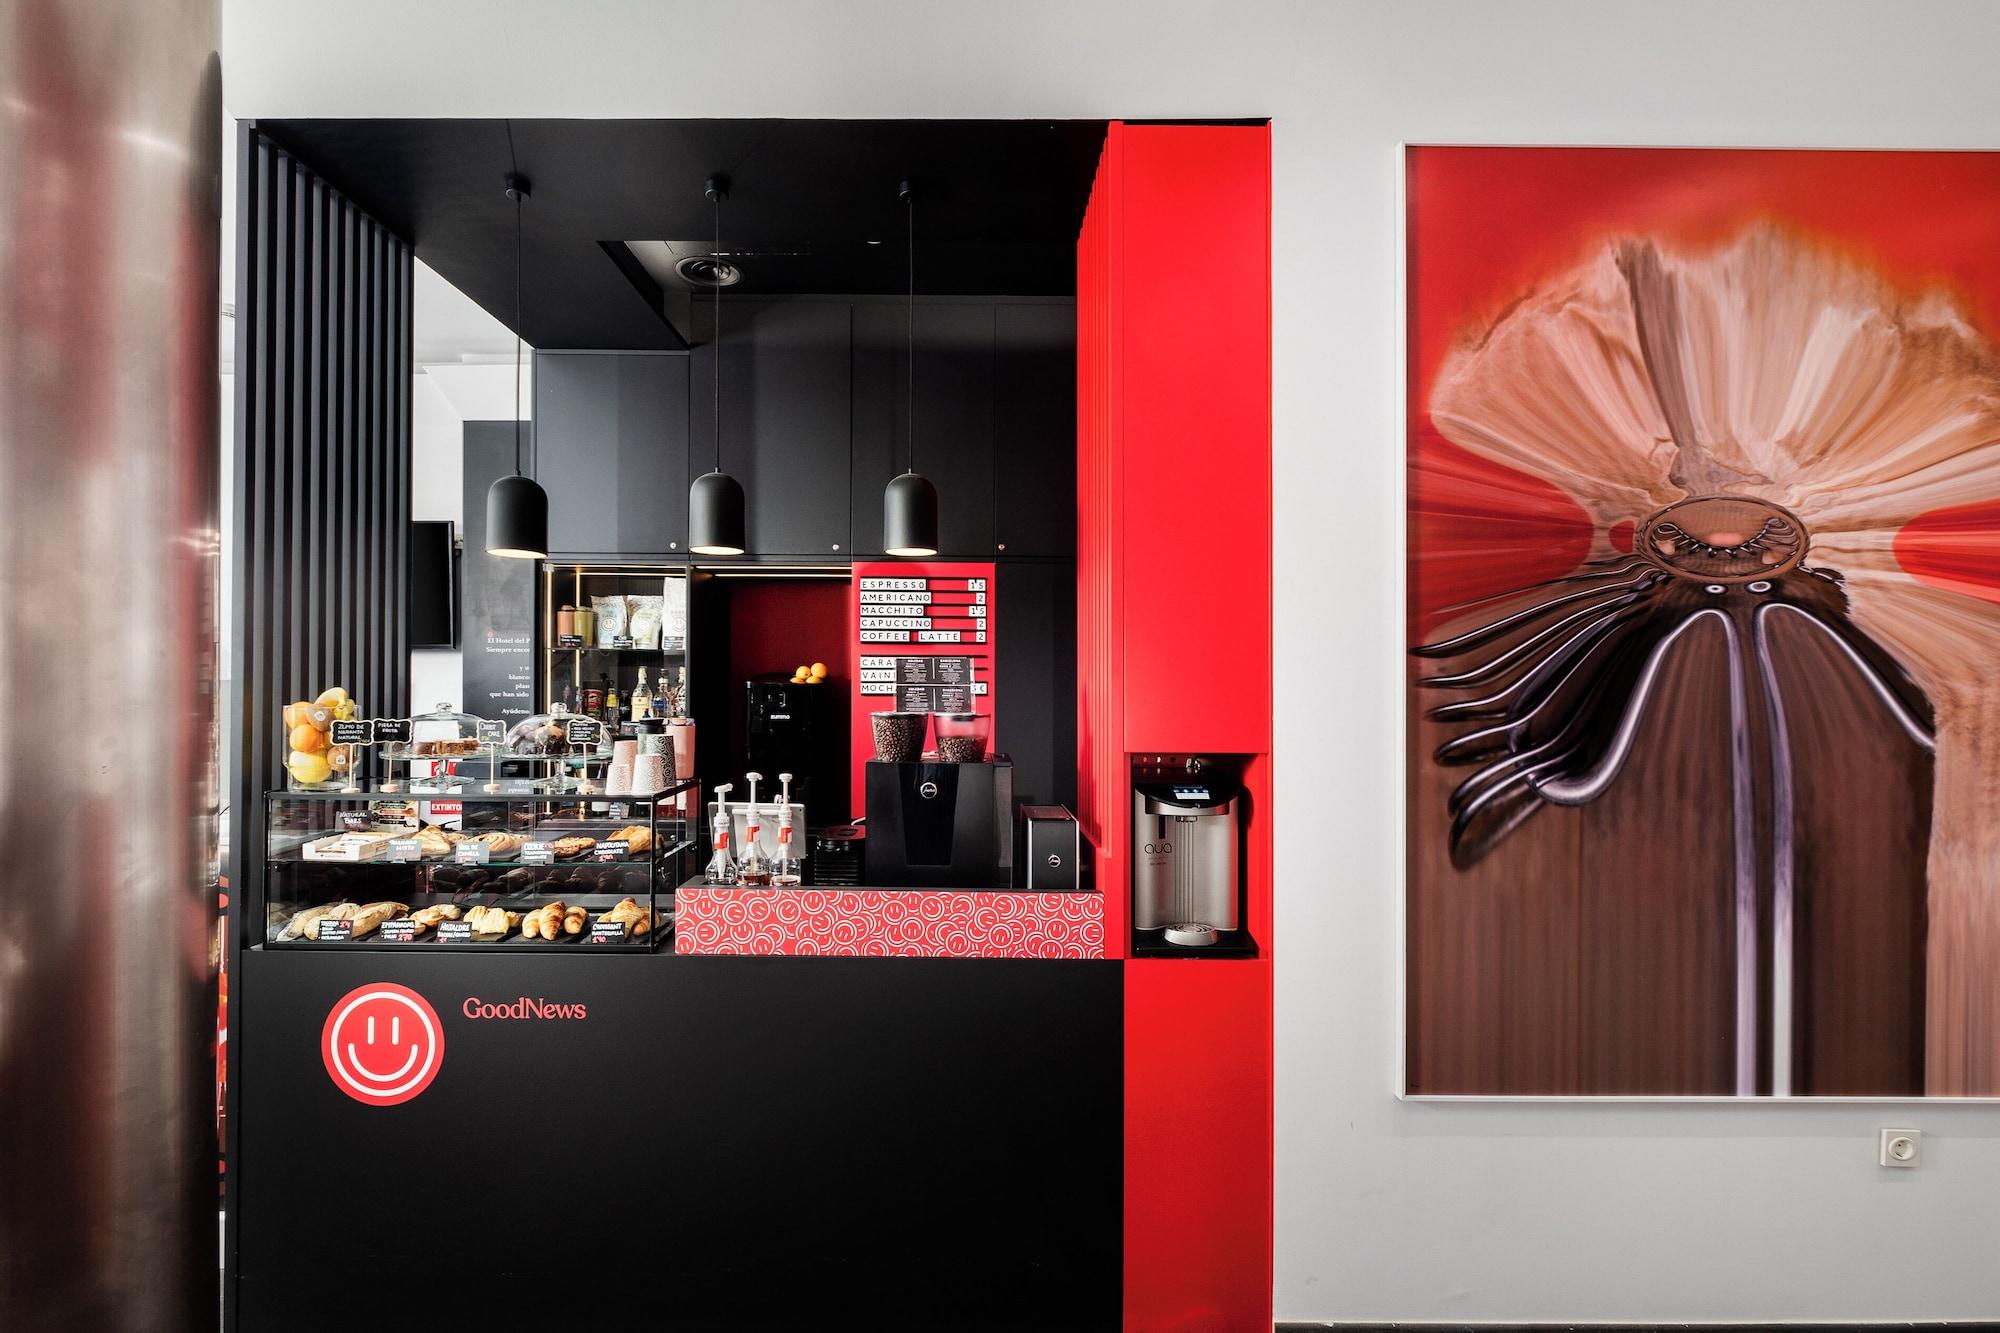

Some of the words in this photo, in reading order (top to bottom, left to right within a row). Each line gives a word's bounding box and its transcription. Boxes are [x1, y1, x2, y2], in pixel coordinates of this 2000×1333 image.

[862, 580, 925, 589] ESPRESSO
[861, 594, 930, 602] AMERICANO
[978, 594, 984, 603] 2
[861, 607, 923, 615] MACCHITO
[861, 619, 931, 628] CAPUCCINO
[978, 619, 984, 628] 2
[861, 632, 908, 640] COFFEE
[920, 632, 959, 641] LATTE
[978, 632, 984, 641] 2
[431, 803, 463, 811] EXTINTO
[463, 996, 587, 1019] GoodNews
